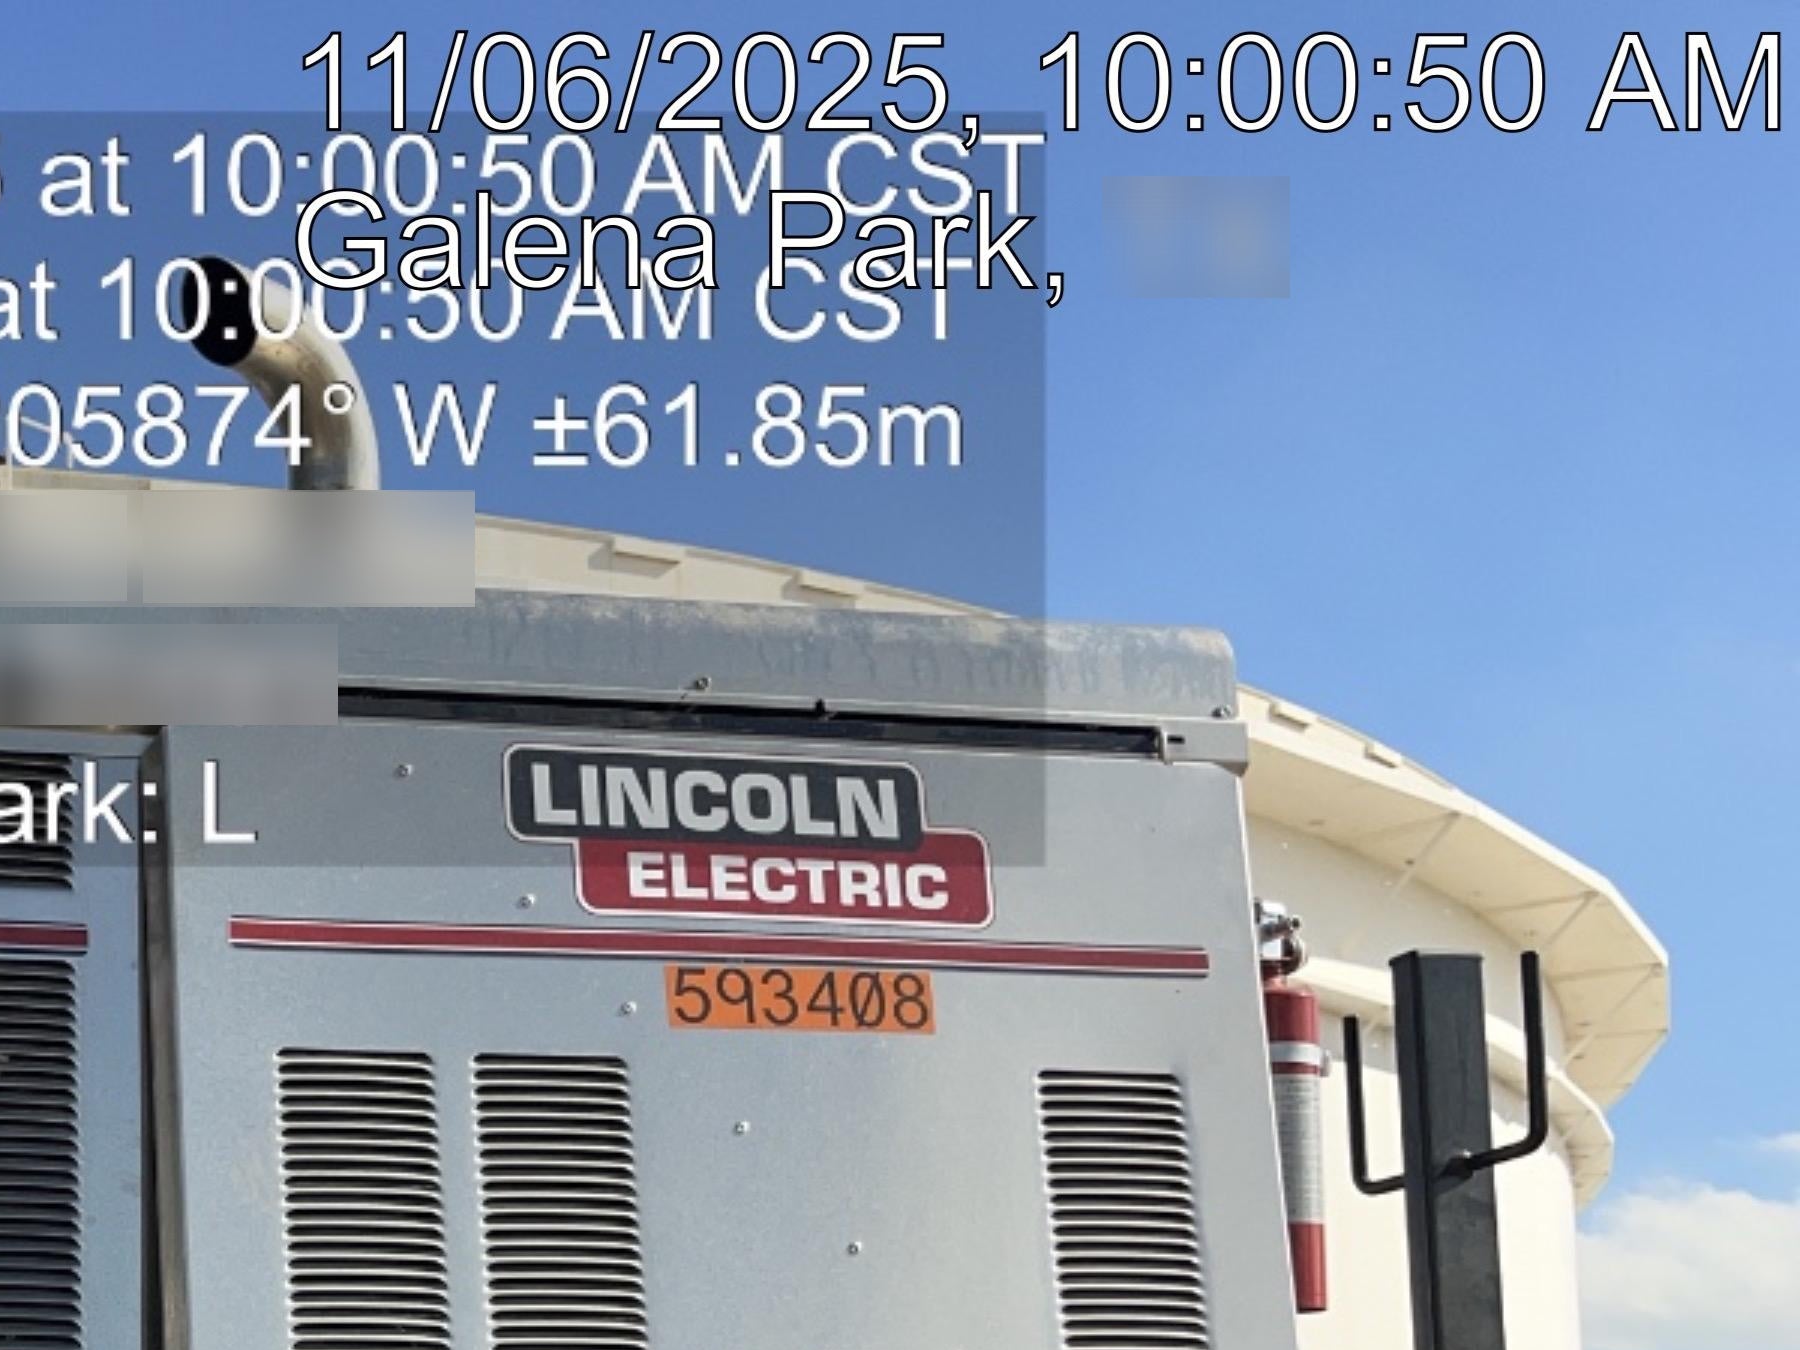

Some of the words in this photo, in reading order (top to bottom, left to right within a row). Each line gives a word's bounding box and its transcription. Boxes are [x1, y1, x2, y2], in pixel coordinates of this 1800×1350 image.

[531, 762, 900, 839] LINCOLN
[626, 851, 949, 910] ELECTRIC
[674, 967, 929, 1030] 593408
